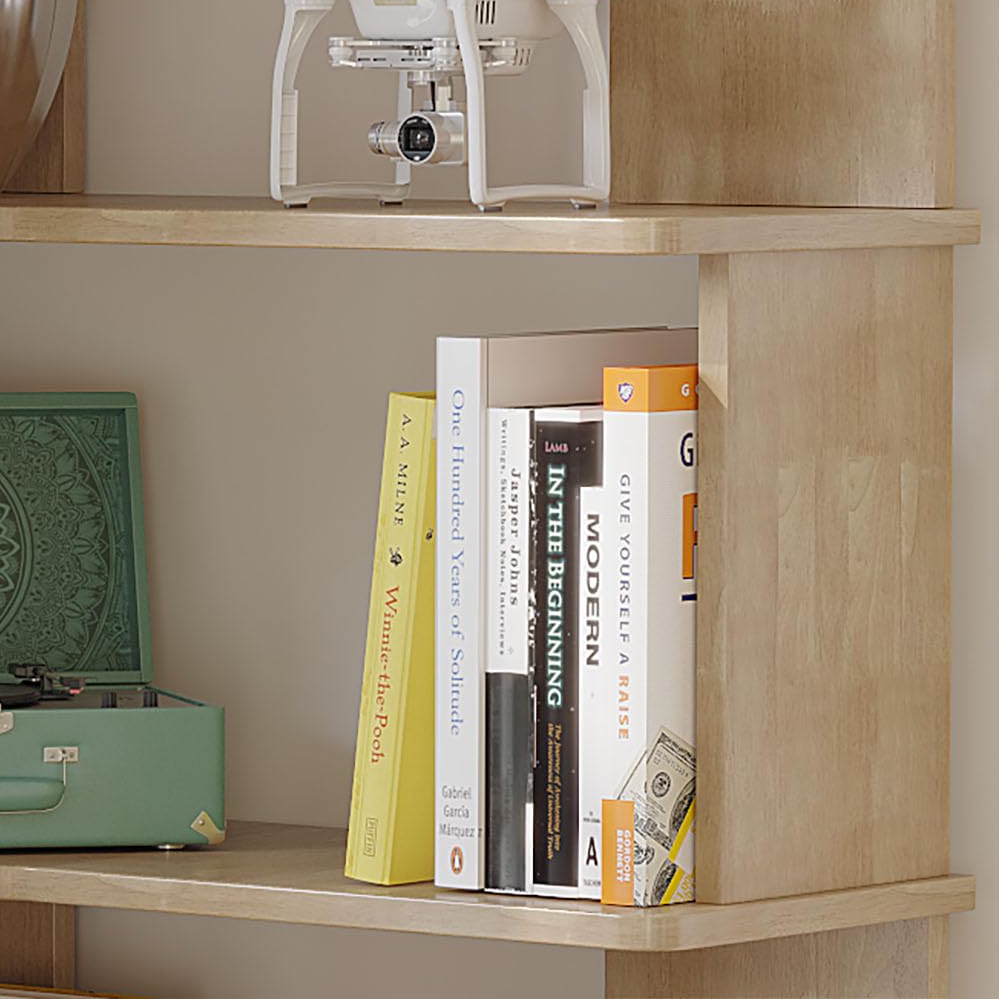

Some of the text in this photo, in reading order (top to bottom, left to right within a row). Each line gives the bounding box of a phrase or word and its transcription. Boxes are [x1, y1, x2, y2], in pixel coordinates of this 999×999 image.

[394, 413, 412, 526] A. A. MILNE
[544, 441, 568, 452] LAMB
[451, 389, 464, 736] One Hundred Years of Solitude
[508, 468, 521, 606] Jasper Johns
[548, 464, 564, 706] IN THE BEGINNING
[586, 514, 600, 666] MODERN
[618, 474, 630, 739] GIVE YOURSELF A RAISE
[371, 586, 399, 763] Winnie-the-Pooh
[440, 823, 475, 839] Márquez
[442, 785, 471, 800] Gabriel
[586, 837, 598, 866] A
[616, 829, 624, 883] BENNETT
[624, 829, 632, 882] GORDON
